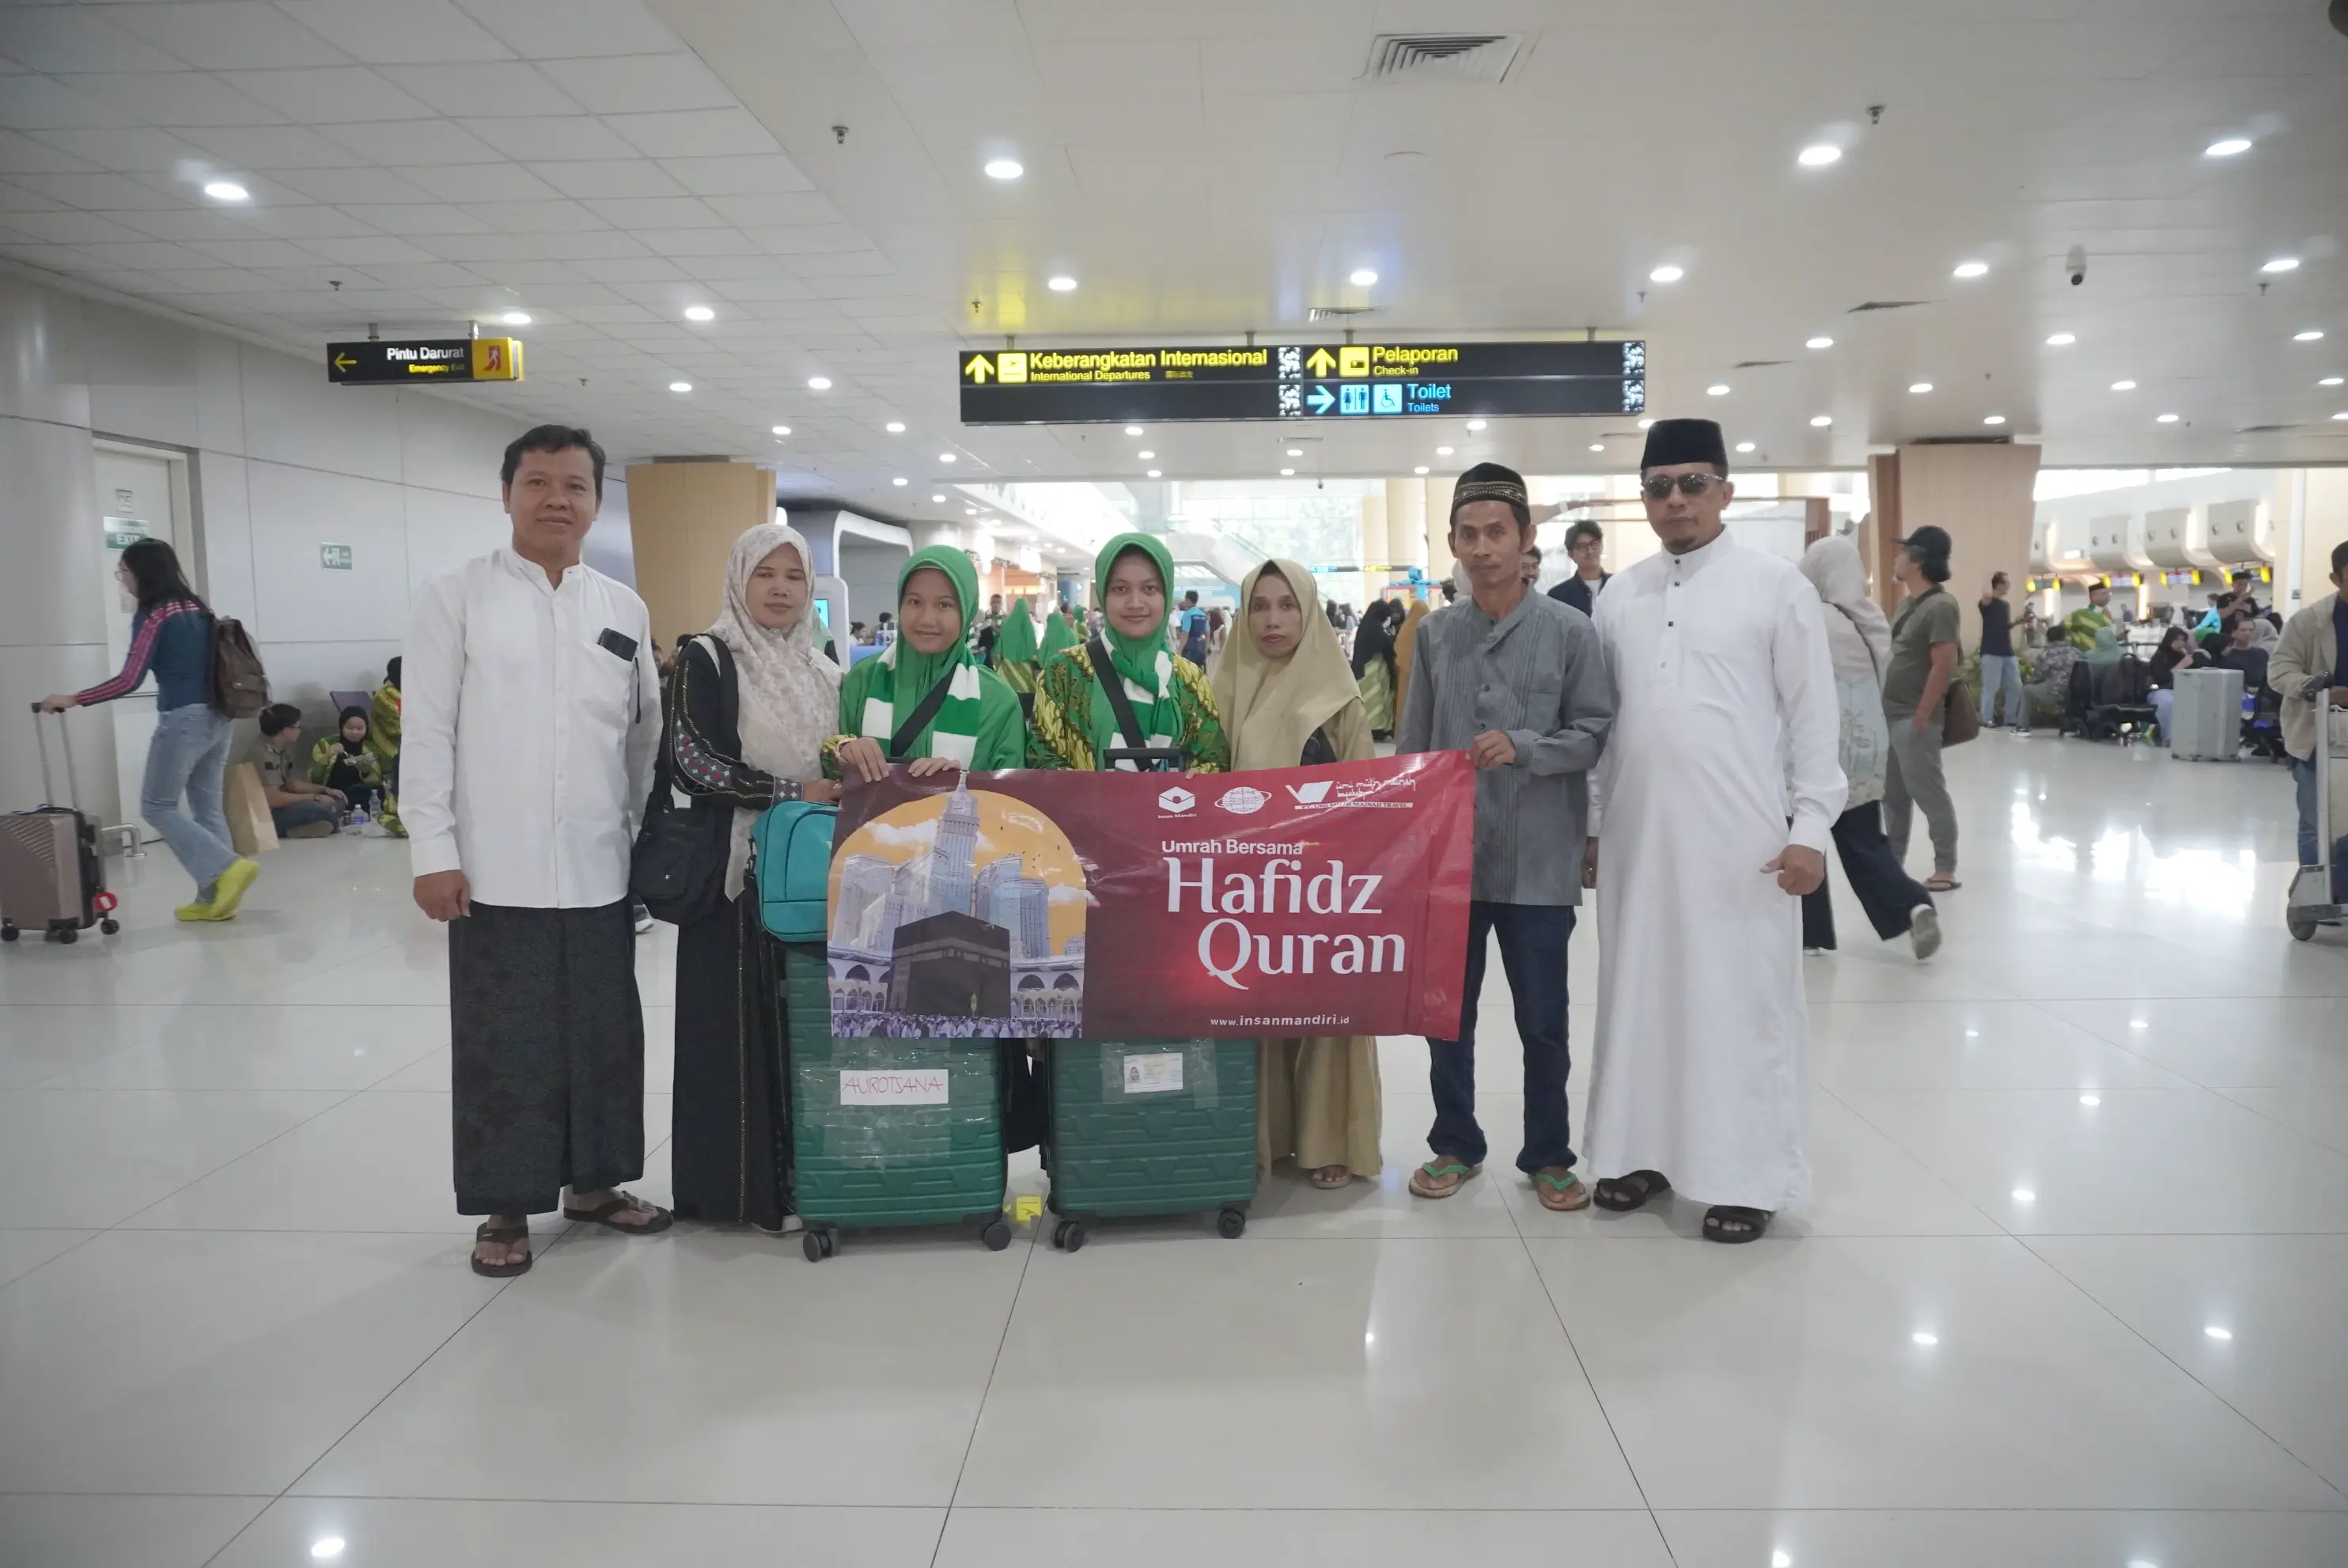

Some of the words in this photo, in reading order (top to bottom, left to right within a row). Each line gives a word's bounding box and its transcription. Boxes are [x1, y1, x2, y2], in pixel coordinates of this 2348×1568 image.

[387, 347, 417, 361] Pintu
[420, 347, 464, 358] Darurat
[1030, 352, 1156, 371] Keberangkatan
[1161, 348, 1267, 367] Internasional
[1373, 346, 1458, 364] Pelaporan
[409, 365, 449, 373] Emergency
[1031, 371, 1093, 381] International
[1095, 371, 1150, 381] Departures
[1374, 365, 1418, 375] Check-in
[1407, 384, 1451, 399] Toilet
[1407, 403, 1439, 412] Toilets
[1161, 839, 1223, 854] Umrah
[1226, 839, 1302, 855] Bersama
[1163, 857, 1383, 915] Hafidz
[1198, 918, 1405, 990] Quran
[1210, 1014, 1350, 1027] www.insanmandiri.id
